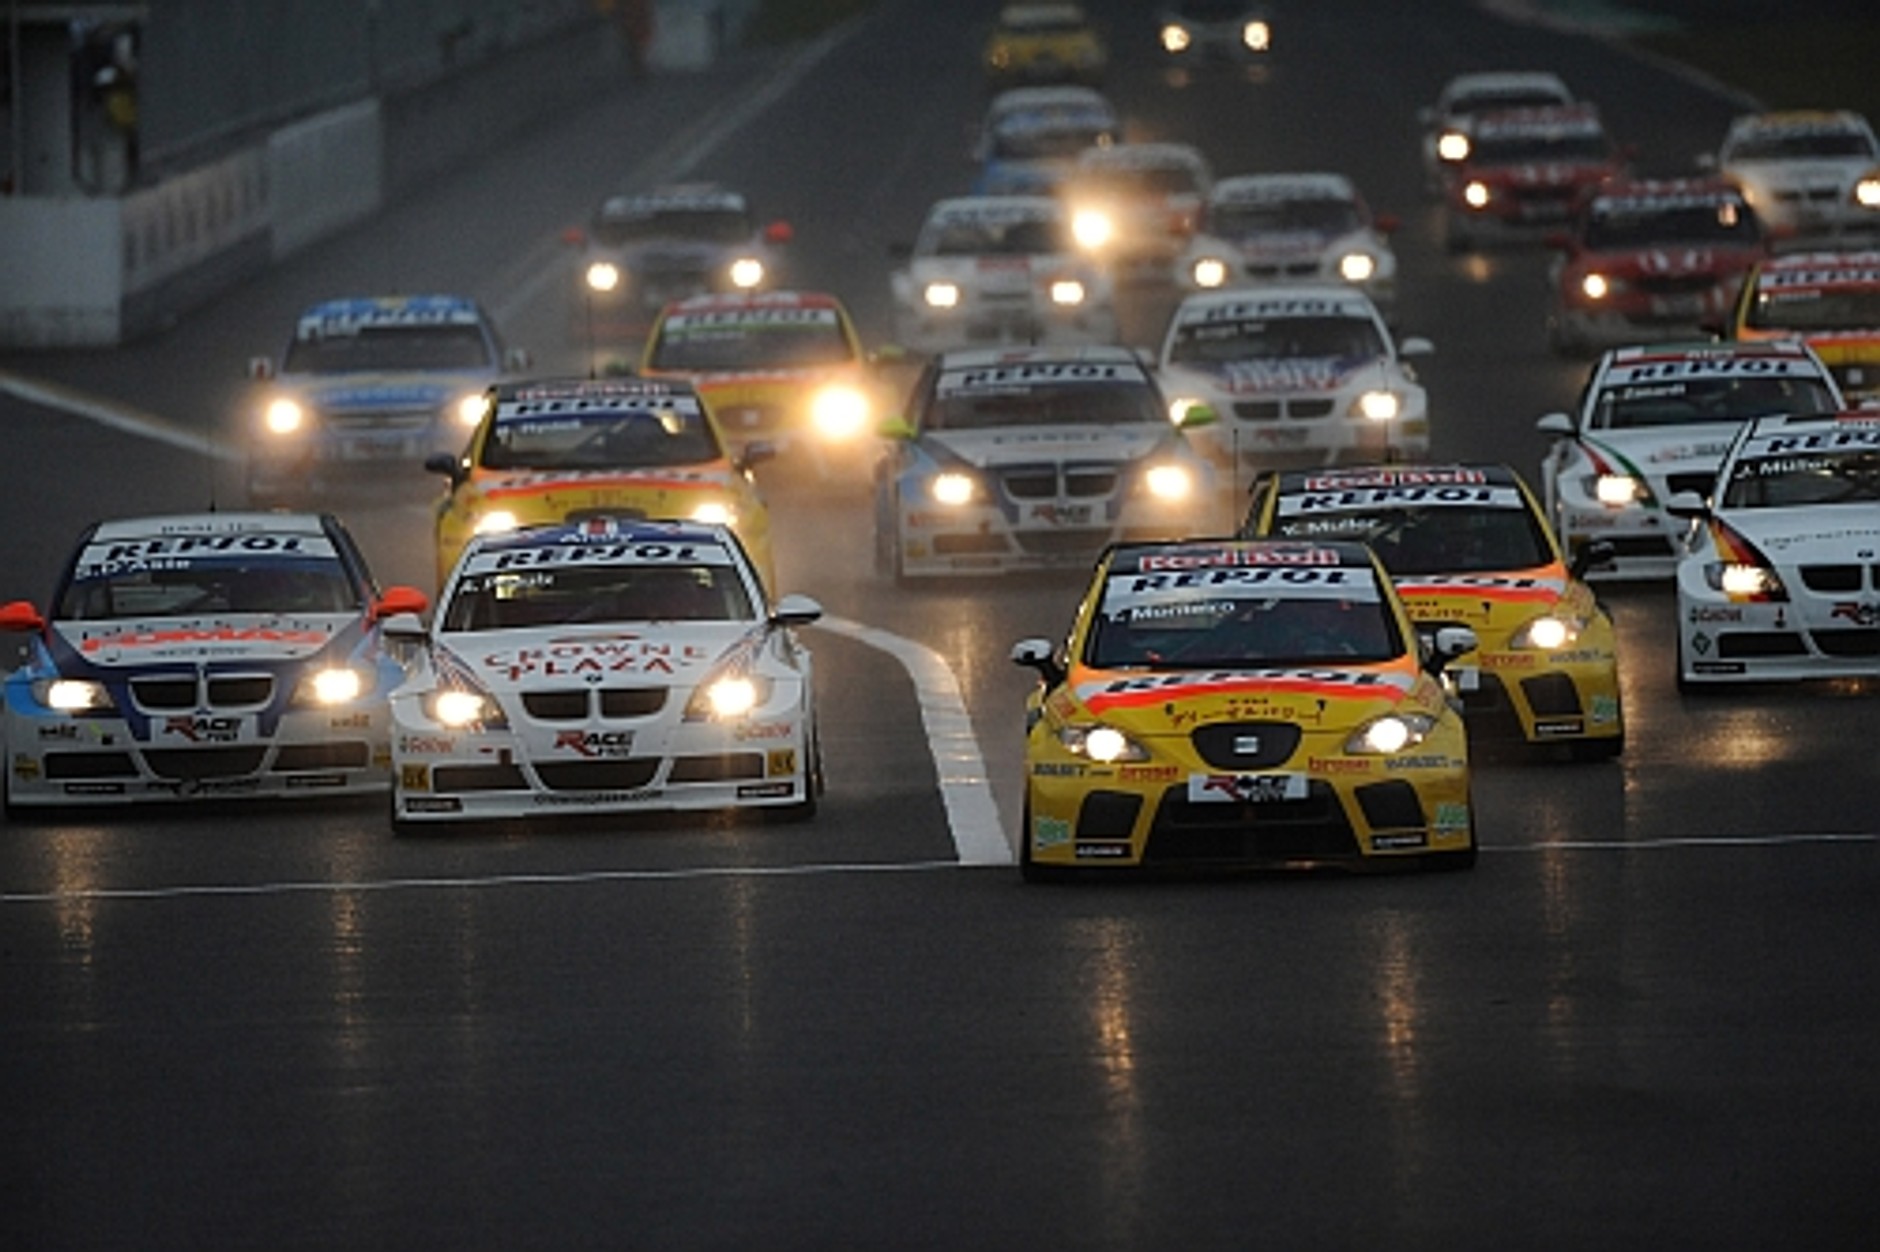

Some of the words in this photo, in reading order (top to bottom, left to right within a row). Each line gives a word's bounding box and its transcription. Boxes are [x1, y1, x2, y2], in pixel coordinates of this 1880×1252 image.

[1301, 488, 1494, 509] REPSOL
[106, 537, 305, 560] REPSOL
[496, 545, 701, 569] REPSOL
[1131, 569, 1350, 592] REPSOL
[484, 643, 710, 667] CROWNE
[503, 657, 674, 682] PLAZA
